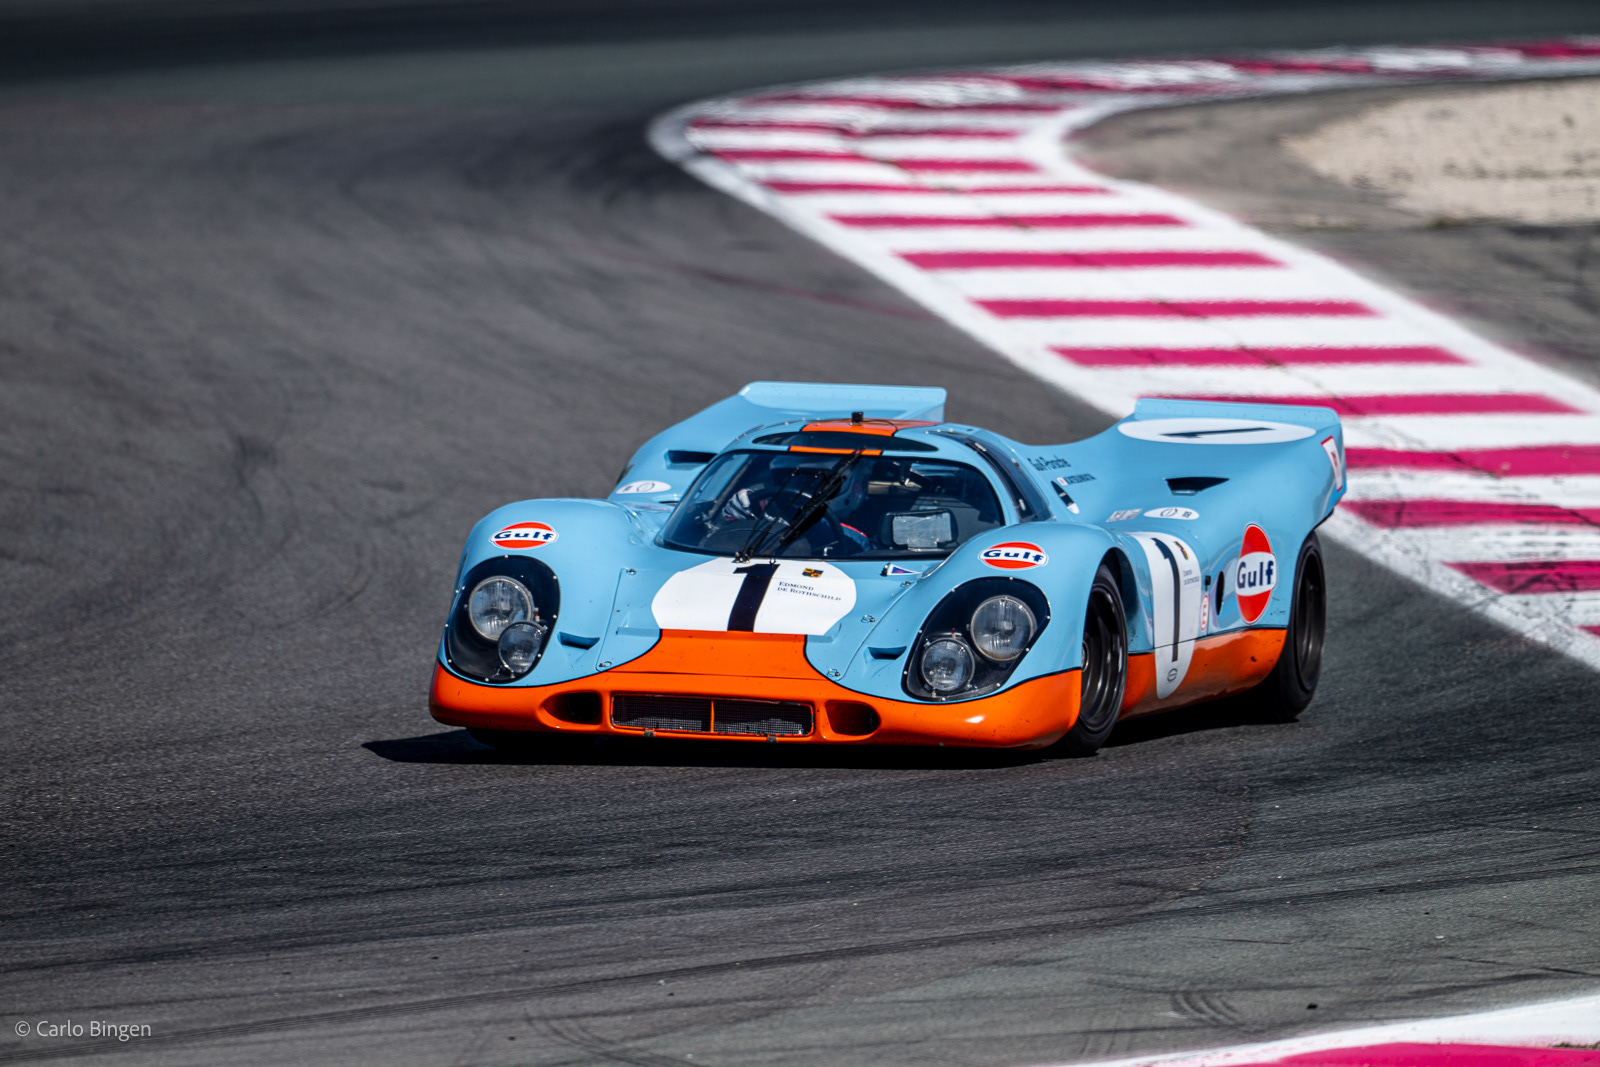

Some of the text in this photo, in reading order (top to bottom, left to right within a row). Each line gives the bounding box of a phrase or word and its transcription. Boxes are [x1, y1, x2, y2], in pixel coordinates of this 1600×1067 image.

[494, 531, 554, 540] Gulf
[983, 549, 1044, 562] Gulf
[1237, 560, 1275, 589] Gulf
[778, 581, 814, 591] EDMOND
[727, 564, 781, 632] 1
[790, 588, 842, 601] ROTHSCHILD
[1151, 538, 1180, 662] 1
